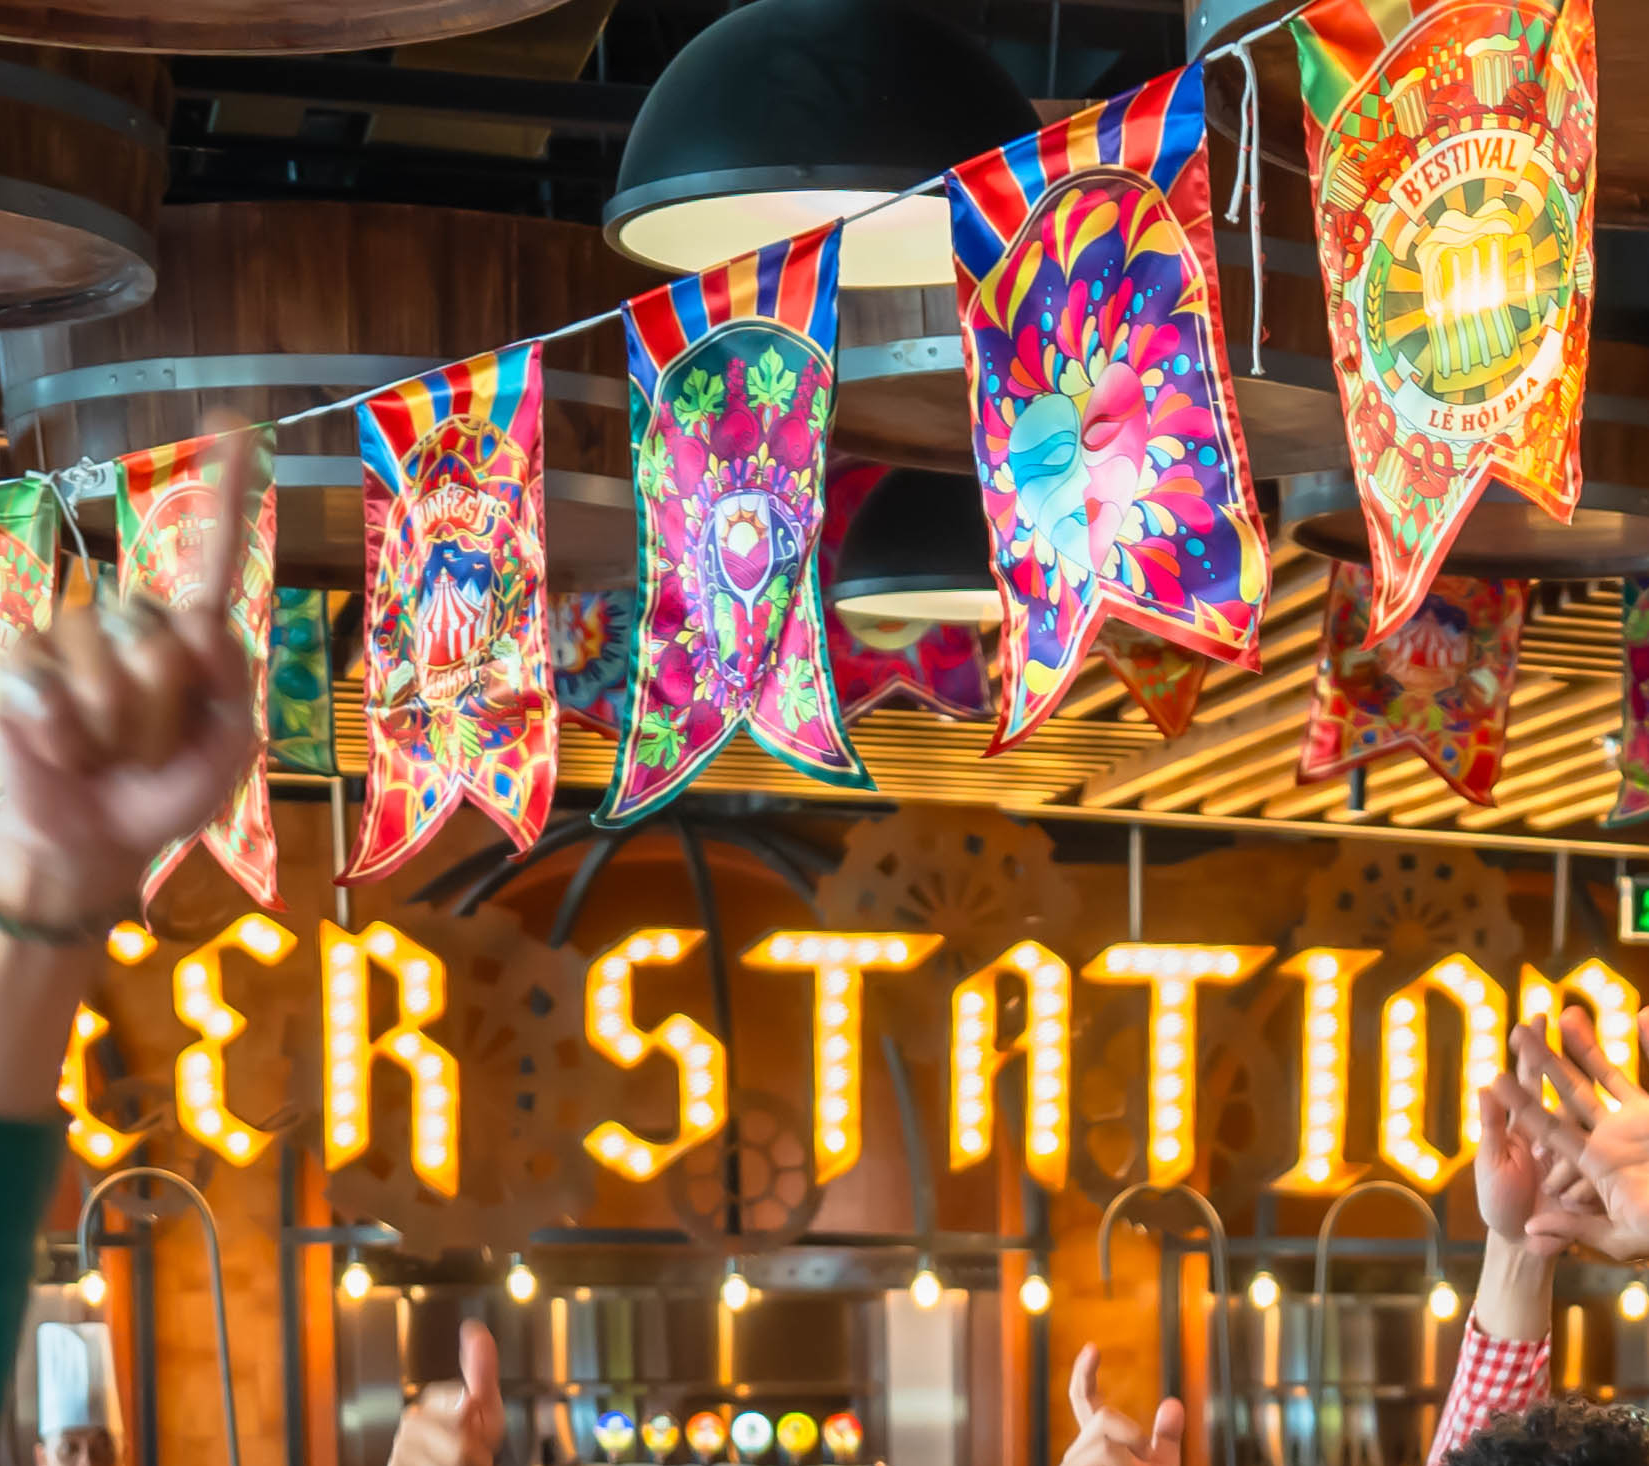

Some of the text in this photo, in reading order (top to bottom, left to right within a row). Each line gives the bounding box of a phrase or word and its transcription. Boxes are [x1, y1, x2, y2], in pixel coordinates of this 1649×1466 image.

[1399, 136, 1519, 208] B'ESTIVAL
[1461, 404, 1500, 433] HỘI
[1504, 376, 1539, 415] BIA
